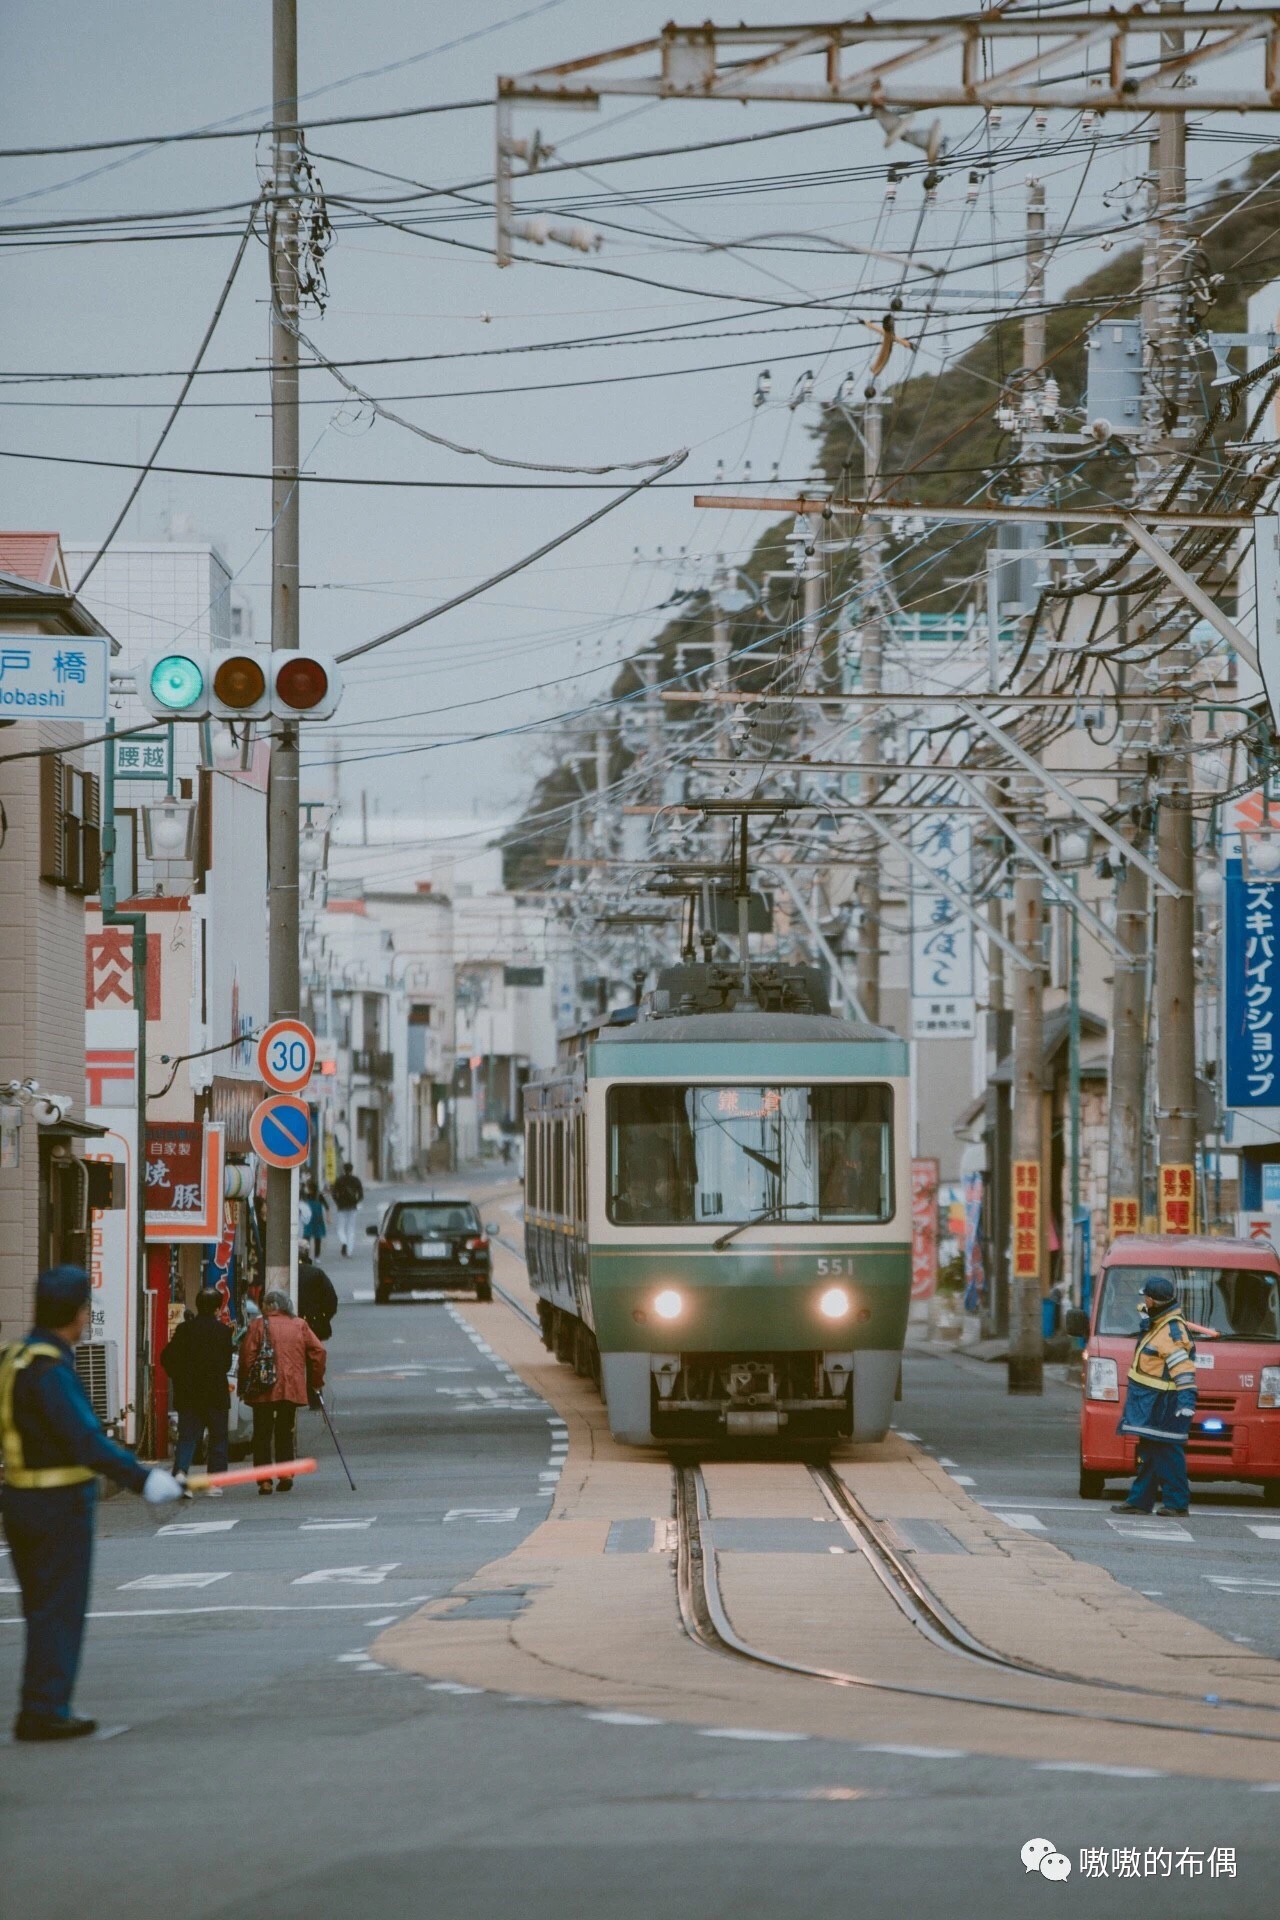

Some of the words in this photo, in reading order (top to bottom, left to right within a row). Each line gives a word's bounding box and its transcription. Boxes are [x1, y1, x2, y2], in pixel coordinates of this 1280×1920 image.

[0, 649, 87, 684] 戸橋
[118, 746, 164, 768] 腰越
[1246, 880, 1275, 1097] ズキバイクショップ
[272, 1041, 306, 1072] 30
[718, 1090, 782, 1112] 鎌倉
[151, 1142, 192, 1156] 自家製
[144, 1159, 204, 1210] 焼豚
[816, 1258, 854, 1276] 551
